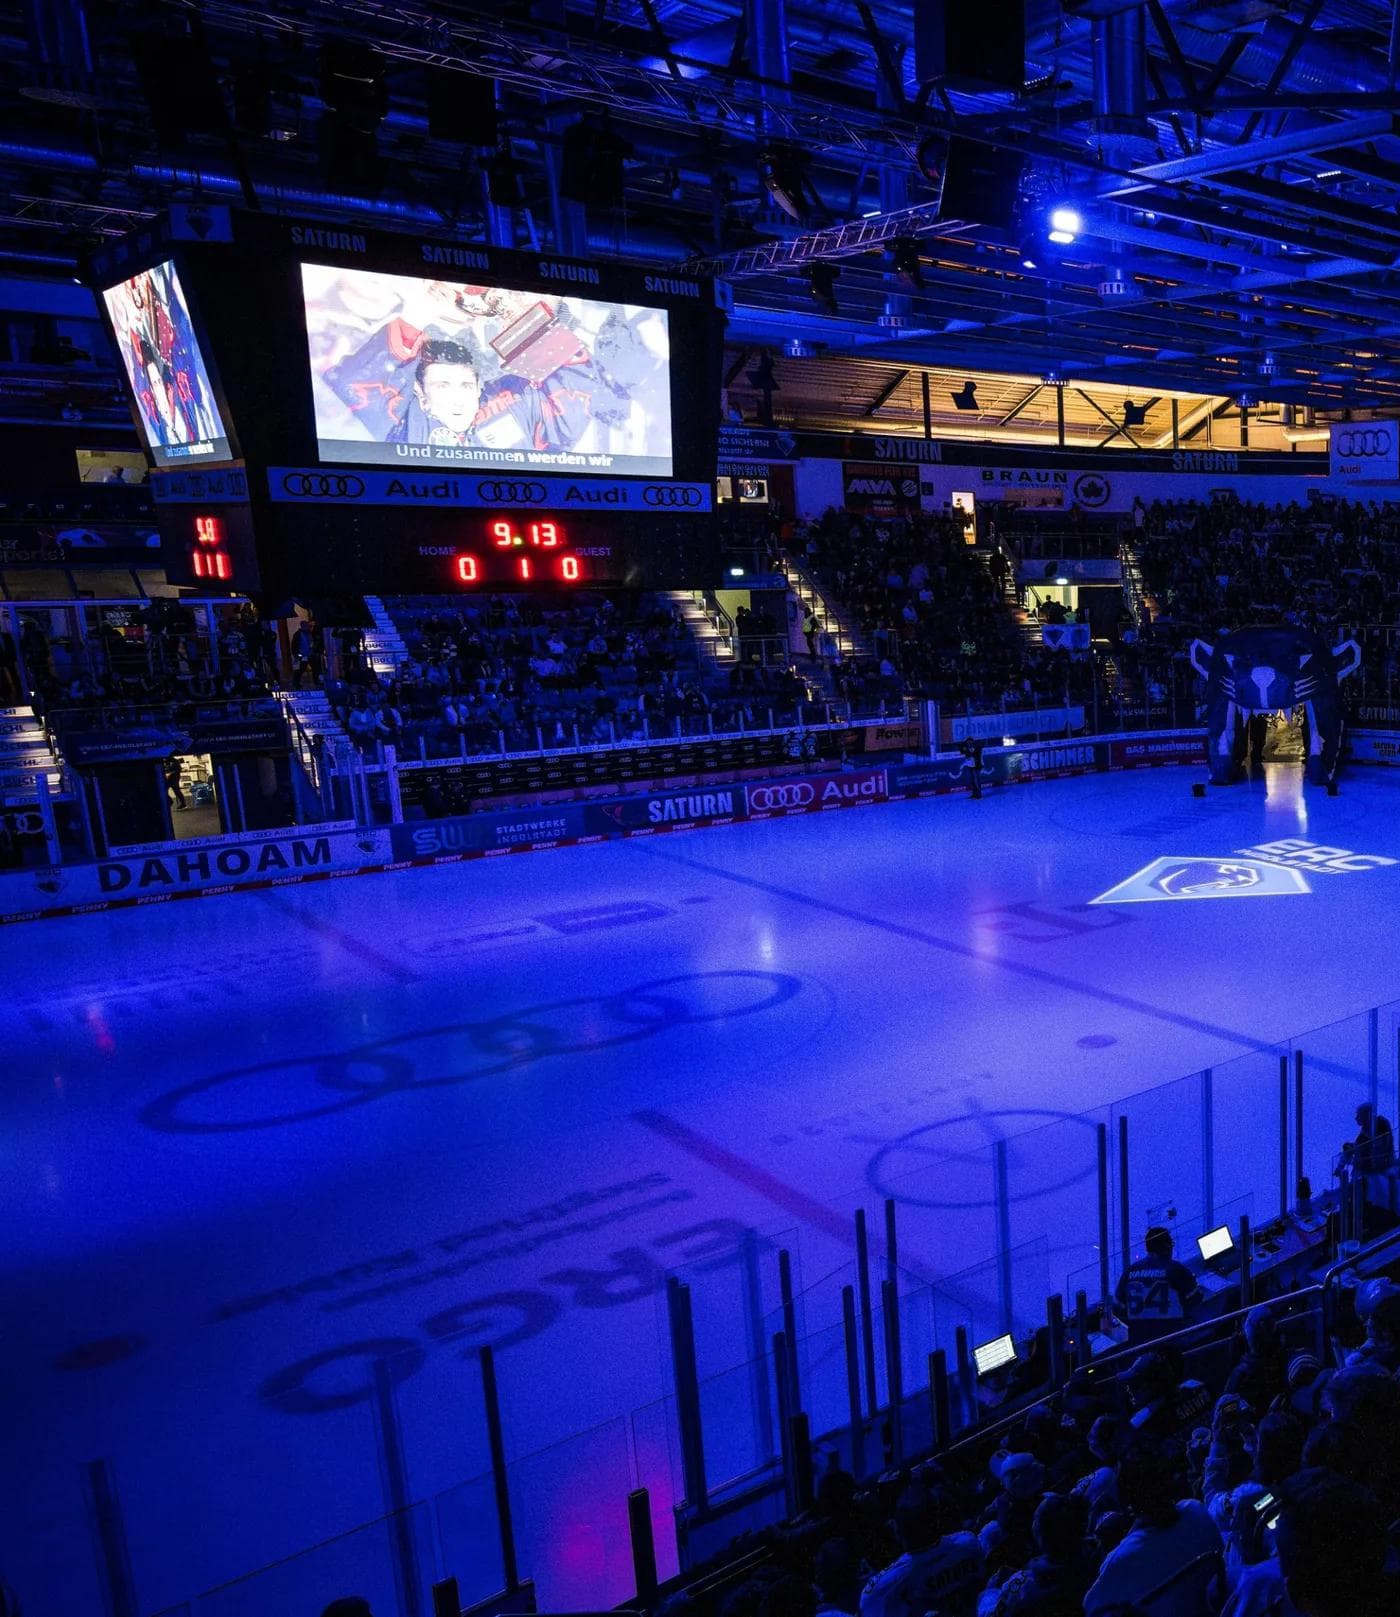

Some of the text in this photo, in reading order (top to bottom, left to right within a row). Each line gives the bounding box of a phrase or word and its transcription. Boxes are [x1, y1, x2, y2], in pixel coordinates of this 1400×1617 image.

[291, 227, 366, 252] SATURN
[422, 245, 489, 270] SATURN
[539, 262, 600, 284] SATURN
[644, 276, 700, 297] SATURN
[396, 445, 613, 467] Und zusammen werden wir
[874, 439, 944, 464] SATURN
[1172, 452, 1239, 472] SATURN
[982, 470, 1067, 483] BRAUN
[386, 479, 460, 499] Audi
[565, 485, 628, 503] Audi
[419, 546, 456, 555] HOME
[575, 547, 612, 556] GUEST
[458, 557, 579, 580] 0 1 0
[821, 775, 883, 801] Audi
[649, 792, 734, 823] SATURN
[496, 819, 567, 834] STADTWERKE
[497, 829, 567, 844] INGOLSTADT
[630, 827, 655, 836] PENNY
[434, 854, 463, 863] PENNY
[485, 847, 510, 856] PENNY
[98, 837, 332, 893] DAHOAM
[384, 860, 413, 870] PENNY
[202, 885, 236, 896] PENNY
